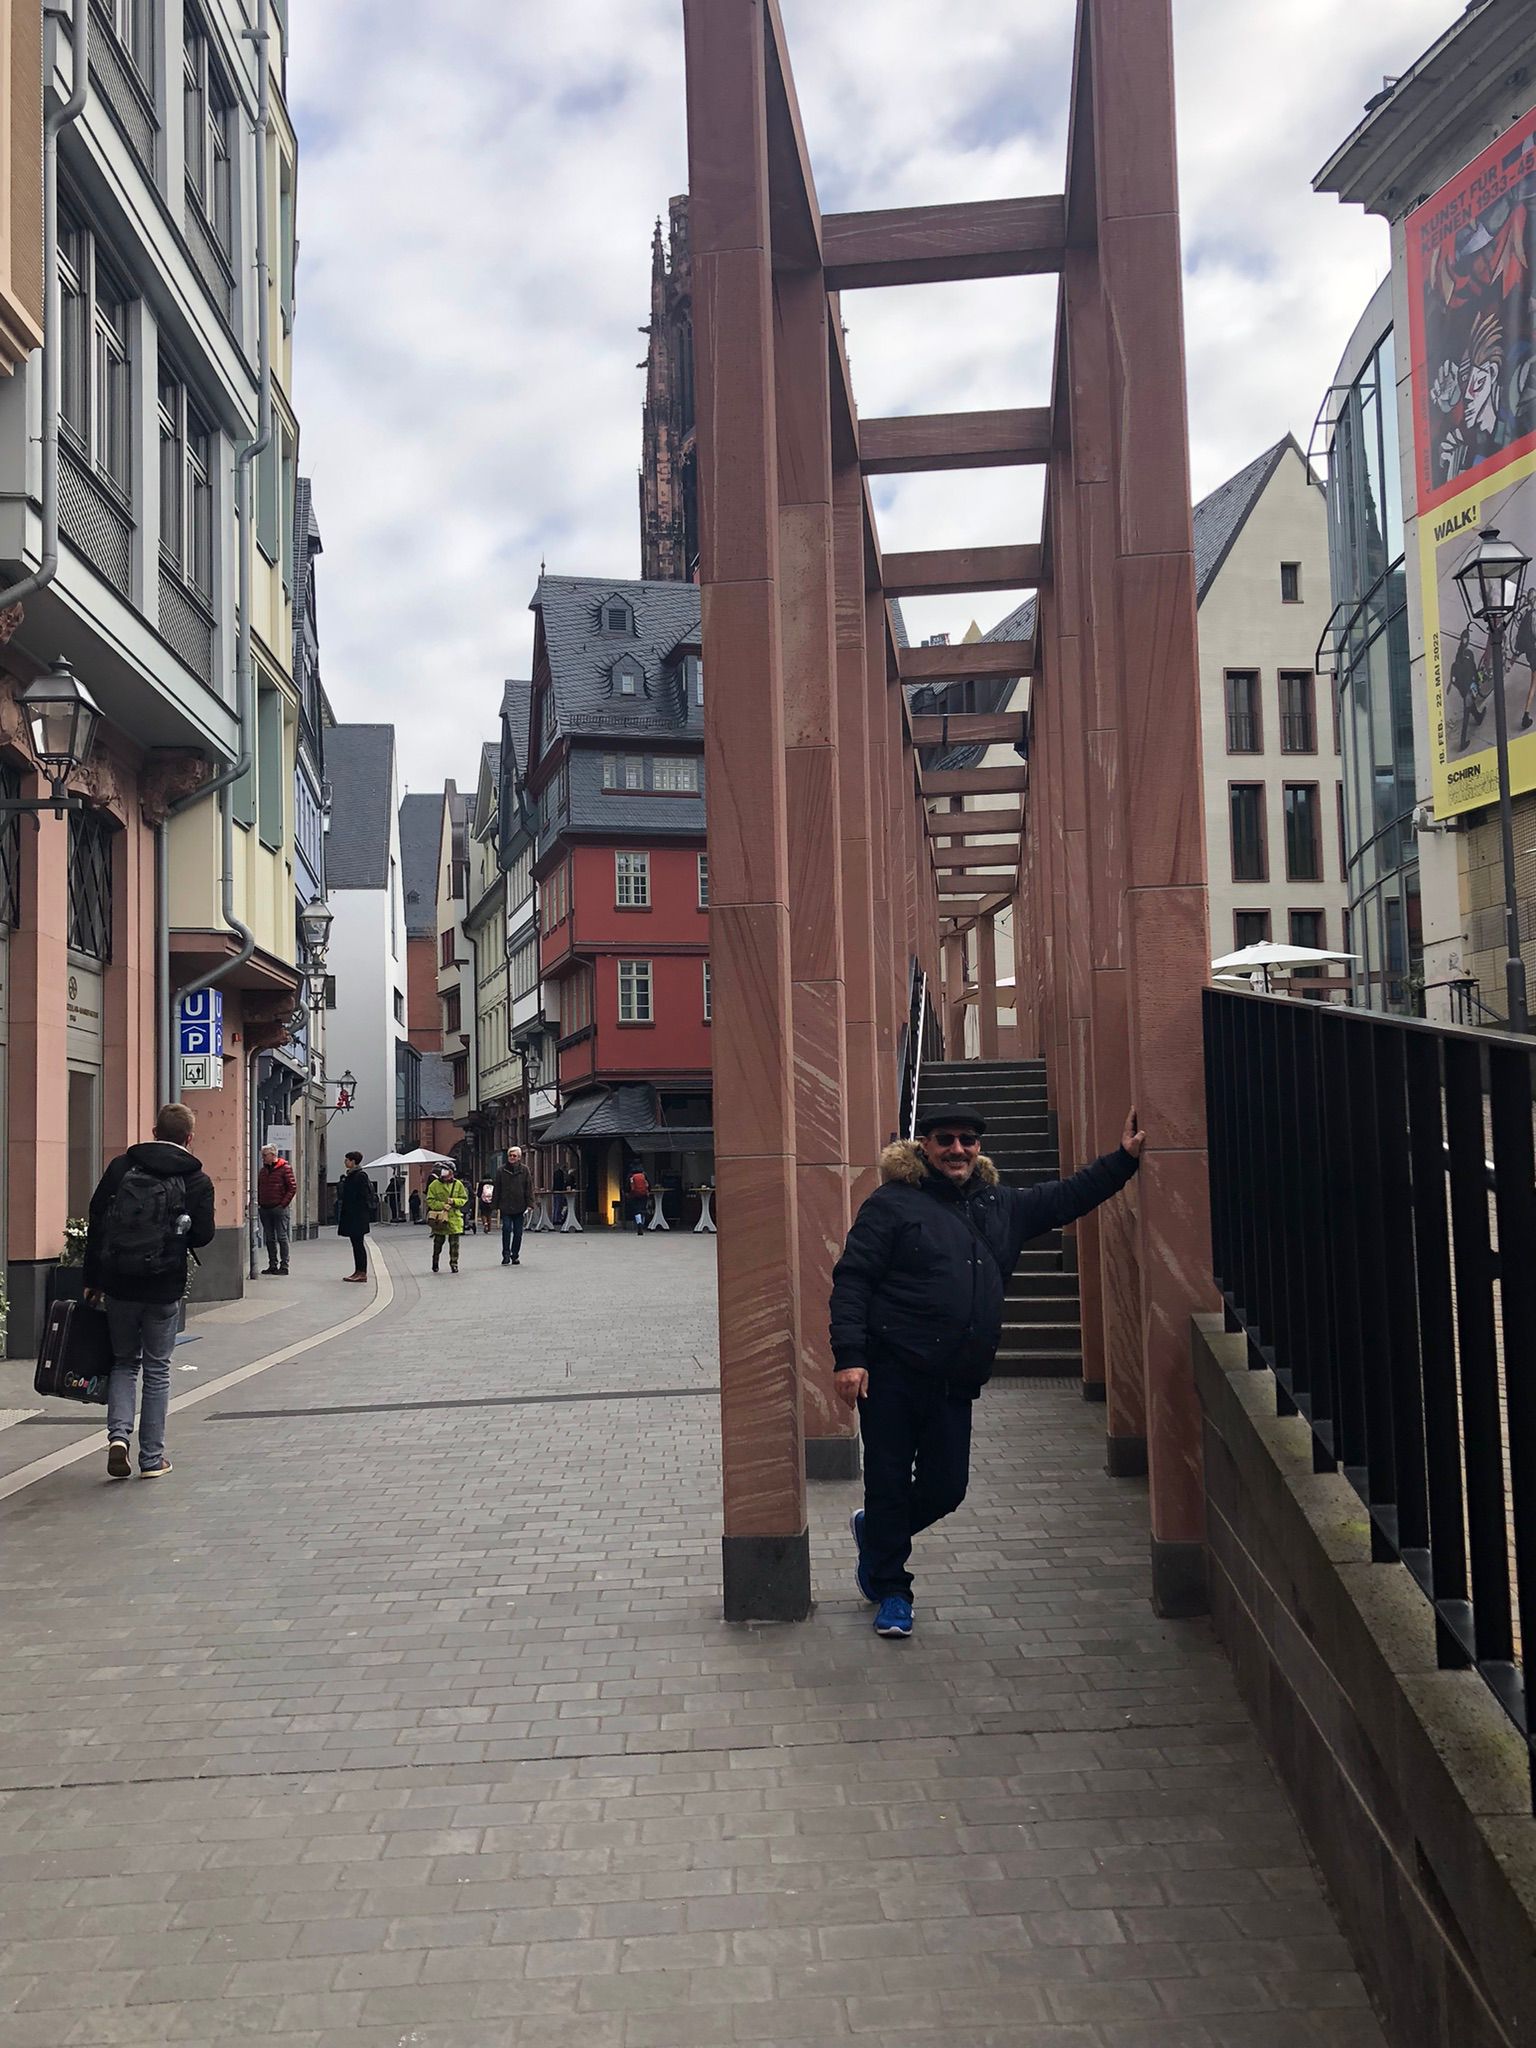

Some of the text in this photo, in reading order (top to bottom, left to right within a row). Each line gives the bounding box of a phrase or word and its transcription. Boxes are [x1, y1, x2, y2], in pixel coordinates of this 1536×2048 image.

[1421, 165, 1497, 239] KUNST FÜR
[1421, 203, 1472, 257] KEINEN
[1434, 505, 1476, 541] WALK!
[1447, 764, 1481, 784] SCHIRN
[185, 994, 203, 1016] U
[216, 996, 222, 1017] U
[188, 1033, 204, 1052] P
